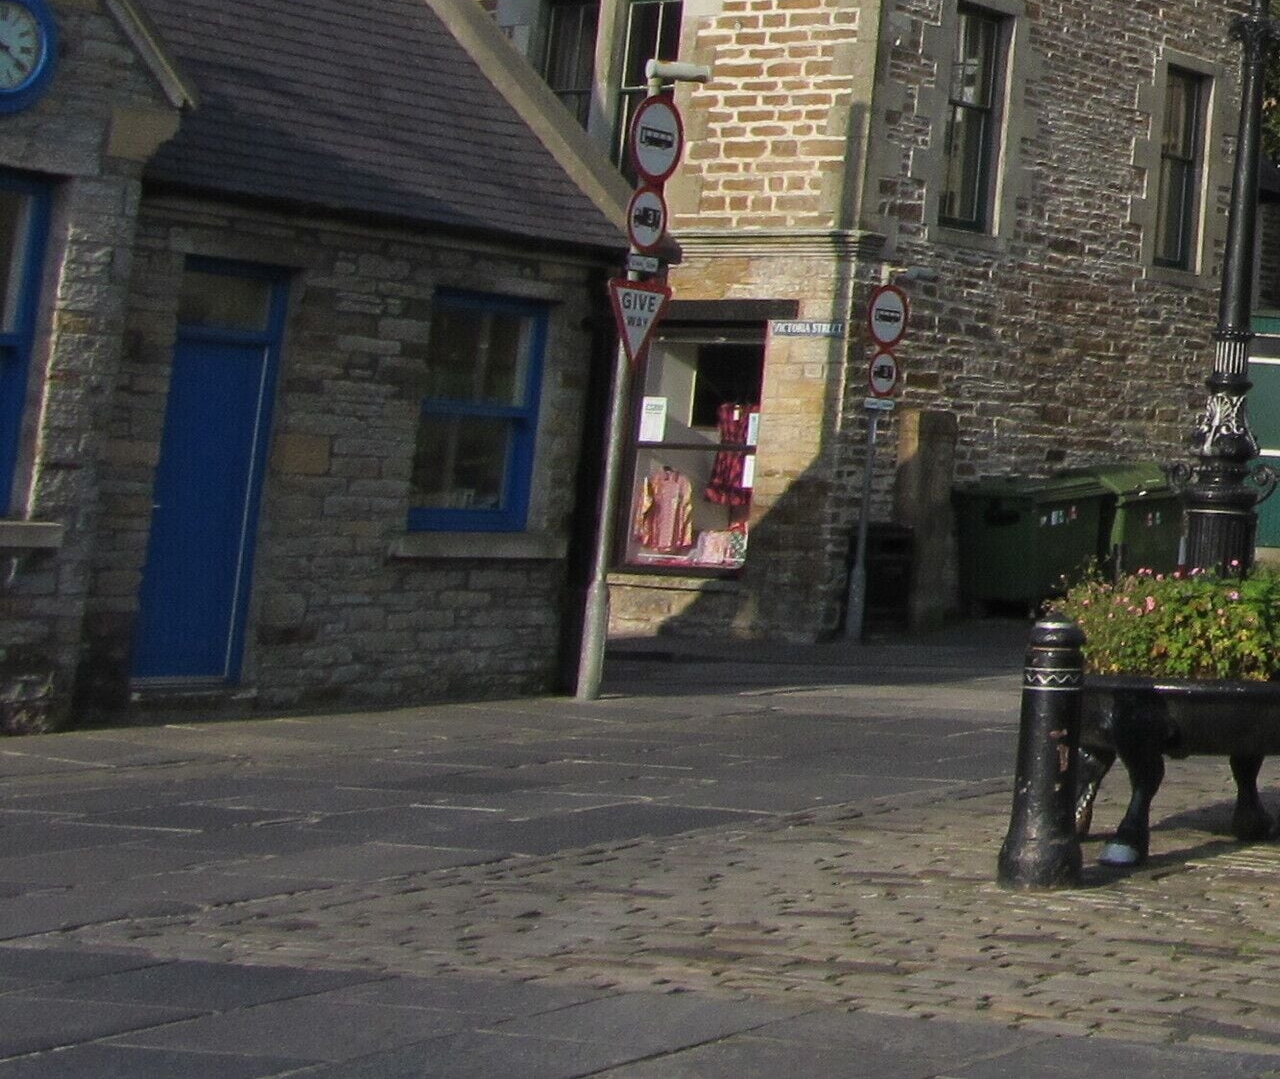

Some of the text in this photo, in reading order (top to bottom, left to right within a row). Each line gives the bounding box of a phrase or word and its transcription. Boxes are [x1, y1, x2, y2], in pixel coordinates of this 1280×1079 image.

[622, 292, 656, 313] GIVE
[627, 317, 648, 327] WAY
[774, 322, 842, 334] VICTORIA STREET
